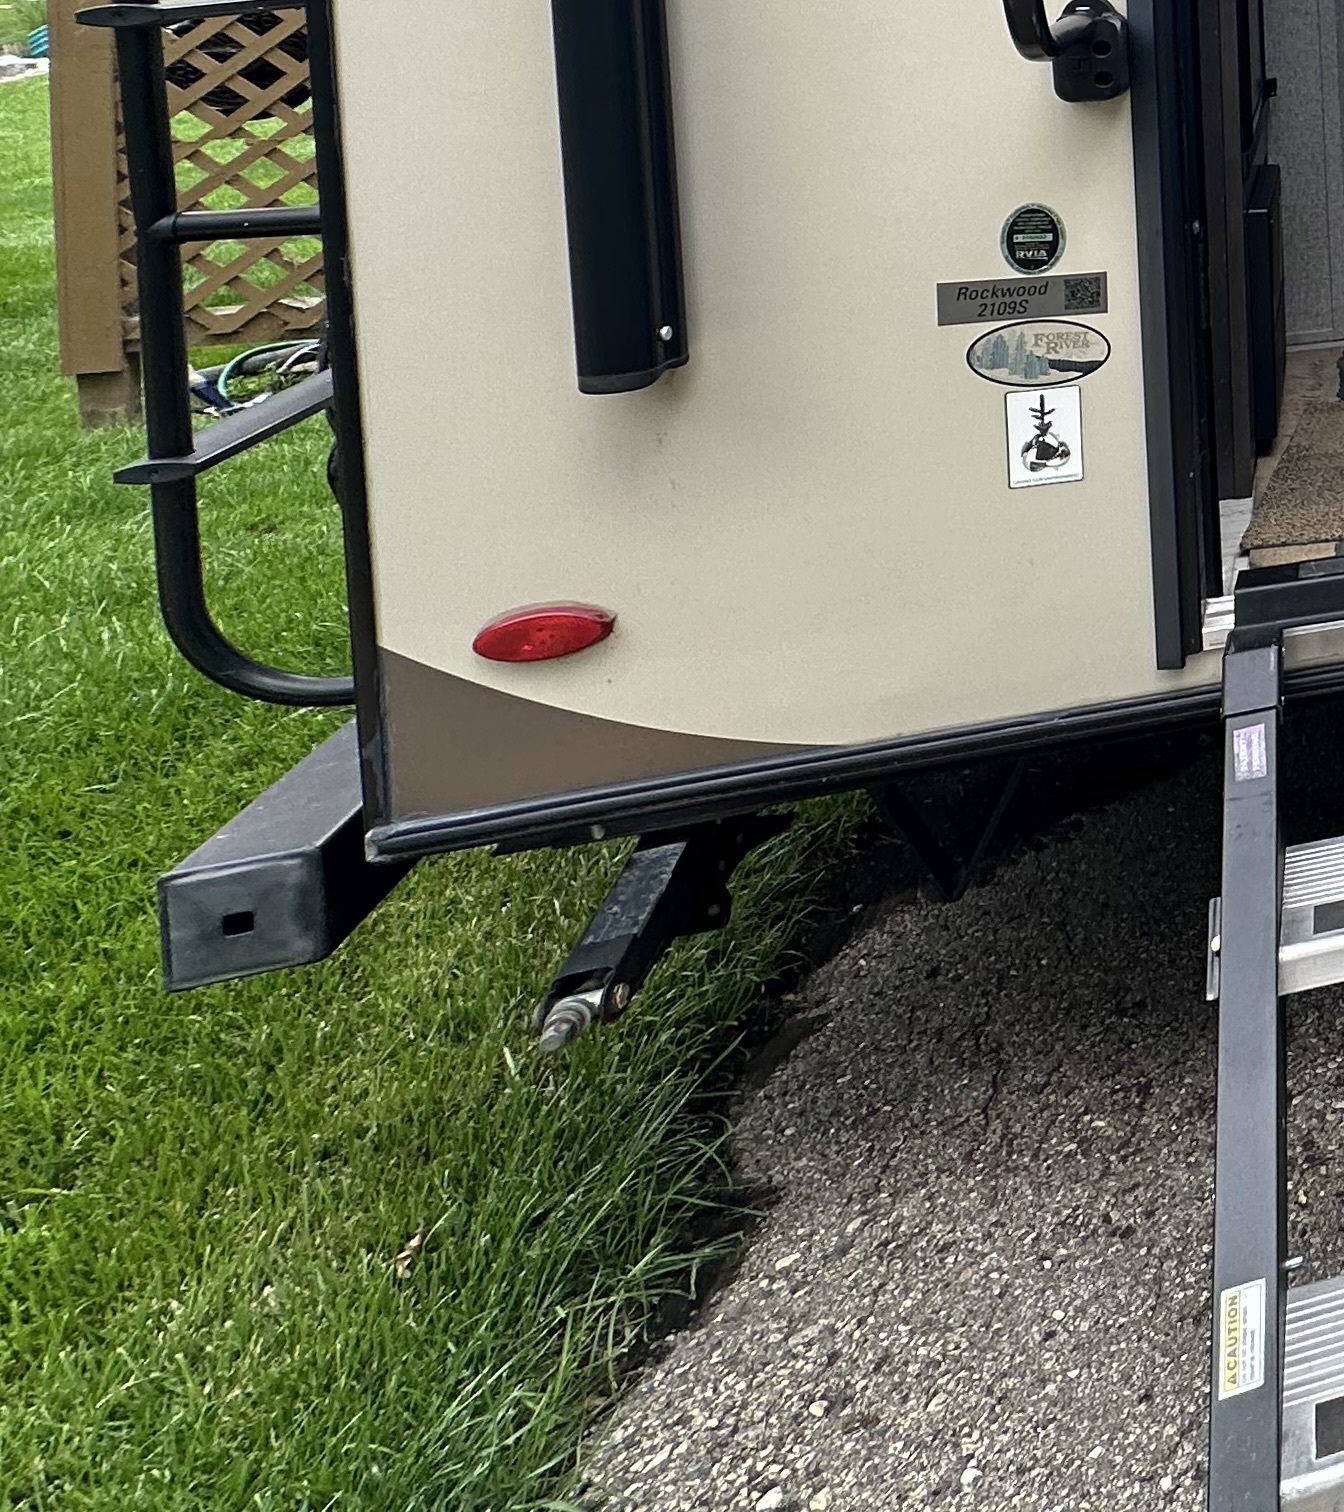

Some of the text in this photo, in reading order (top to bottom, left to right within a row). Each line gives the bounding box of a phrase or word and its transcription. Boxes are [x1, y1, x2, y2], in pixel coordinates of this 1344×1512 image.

[1015, 249, 1048, 259] RVIA
[956, 281, 1049, 301] Rockwood
[977, 300, 1029, 318] 2109S
[1033, 331, 1090, 348] FOREST
[1045, 338, 1091, 355] RIVER
[1227, 1295, 1238, 1371] CAUTION
